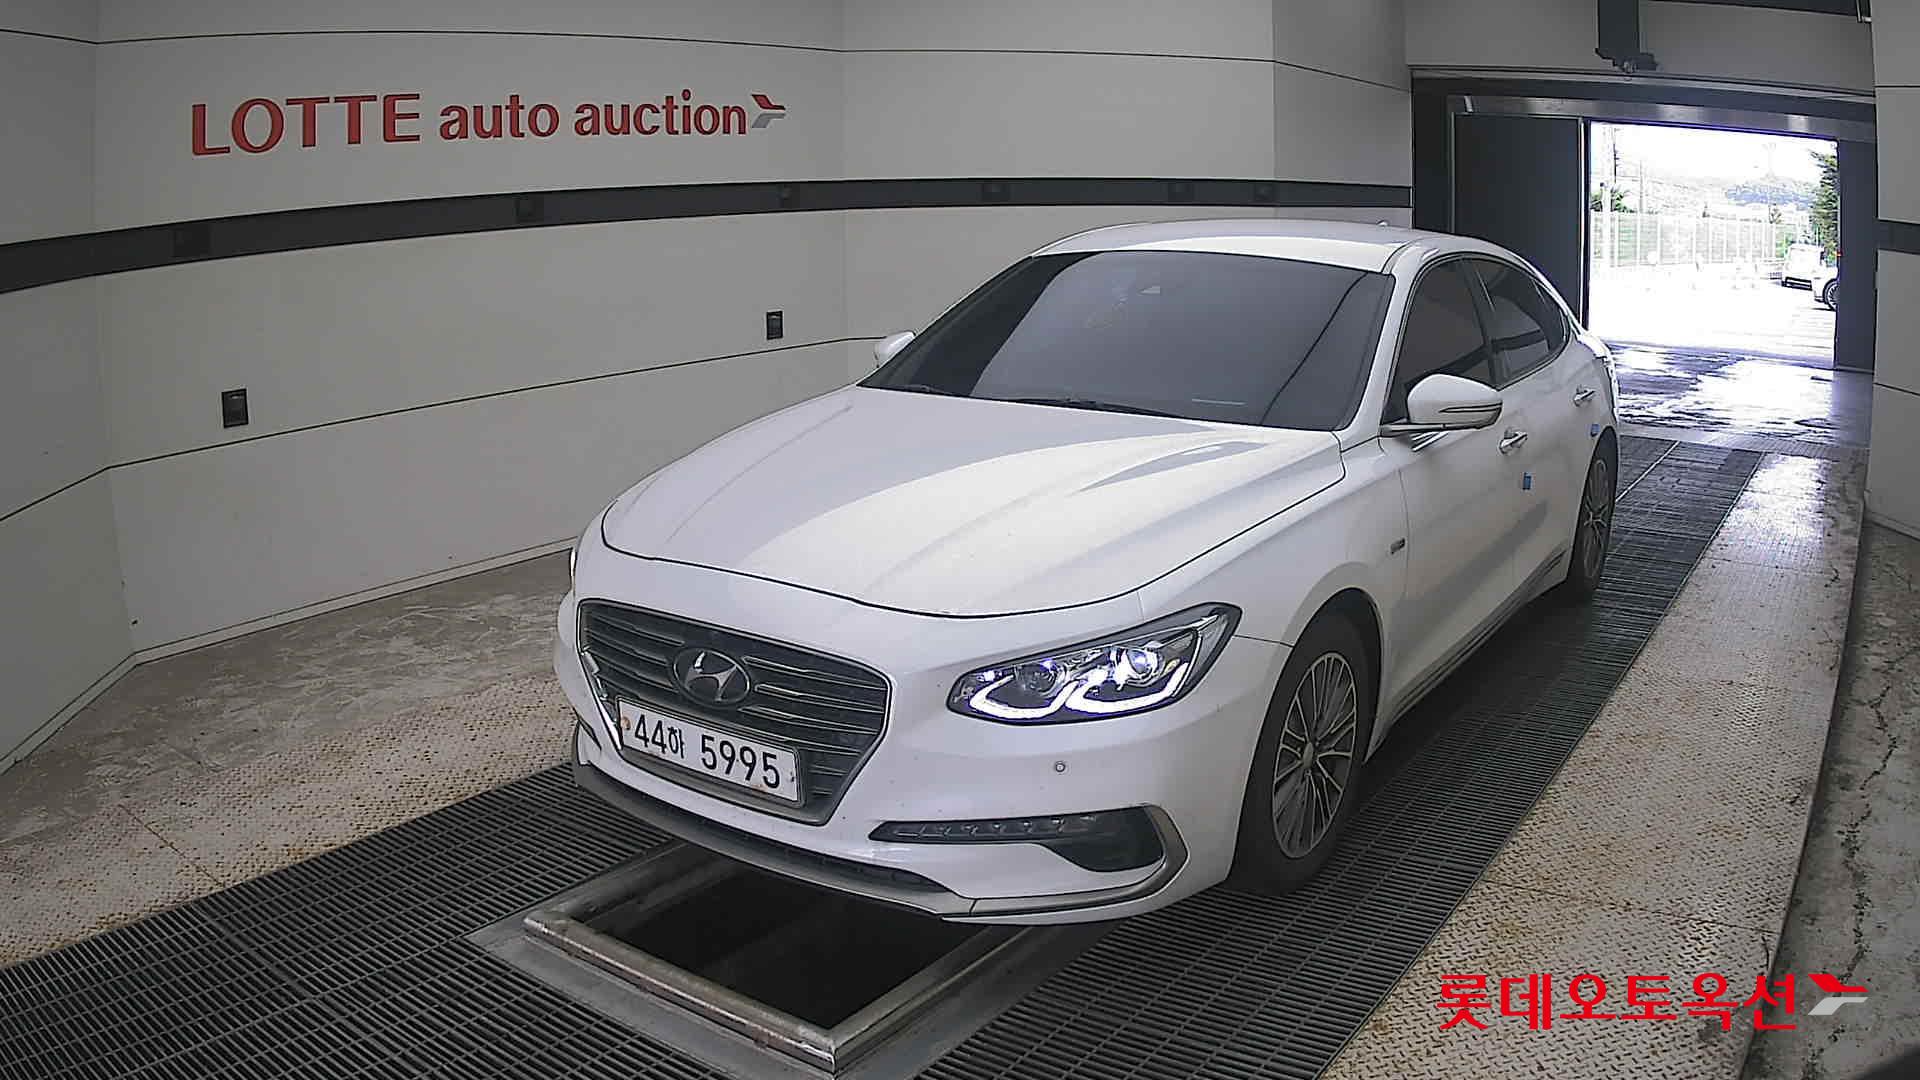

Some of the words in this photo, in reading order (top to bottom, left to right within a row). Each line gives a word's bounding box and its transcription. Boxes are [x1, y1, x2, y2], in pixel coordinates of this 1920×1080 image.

[192, 93, 421, 155] LOTTE
[438, 93, 560, 141] auto
[574, 89, 747, 137] auction
[634, 714, 685, 759] 44하
[700, 734, 781, 789] 5995
